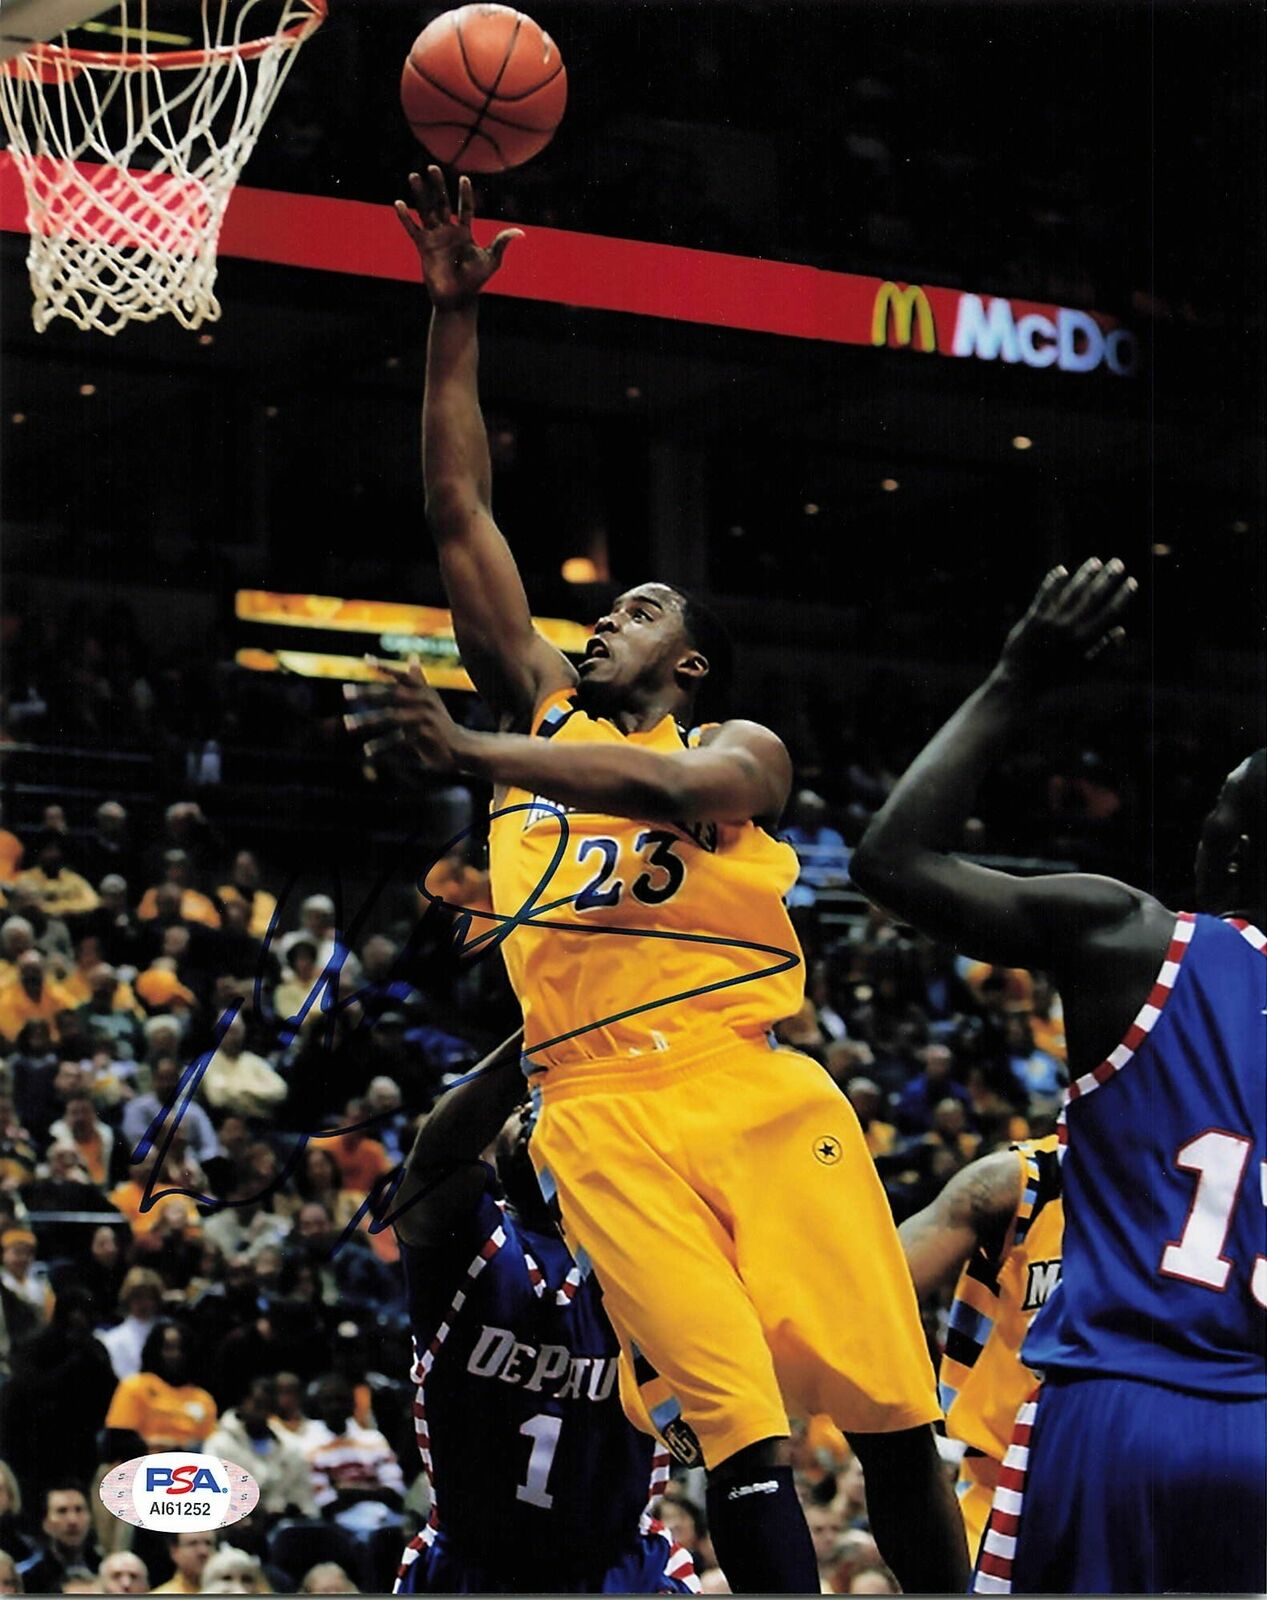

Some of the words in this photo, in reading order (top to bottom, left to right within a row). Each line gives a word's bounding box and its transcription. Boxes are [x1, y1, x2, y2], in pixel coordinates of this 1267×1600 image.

[574, 828, 687, 914] 23
[1157, 1126, 1267, 1309] 1
[515, 1413, 563, 1509] 1
